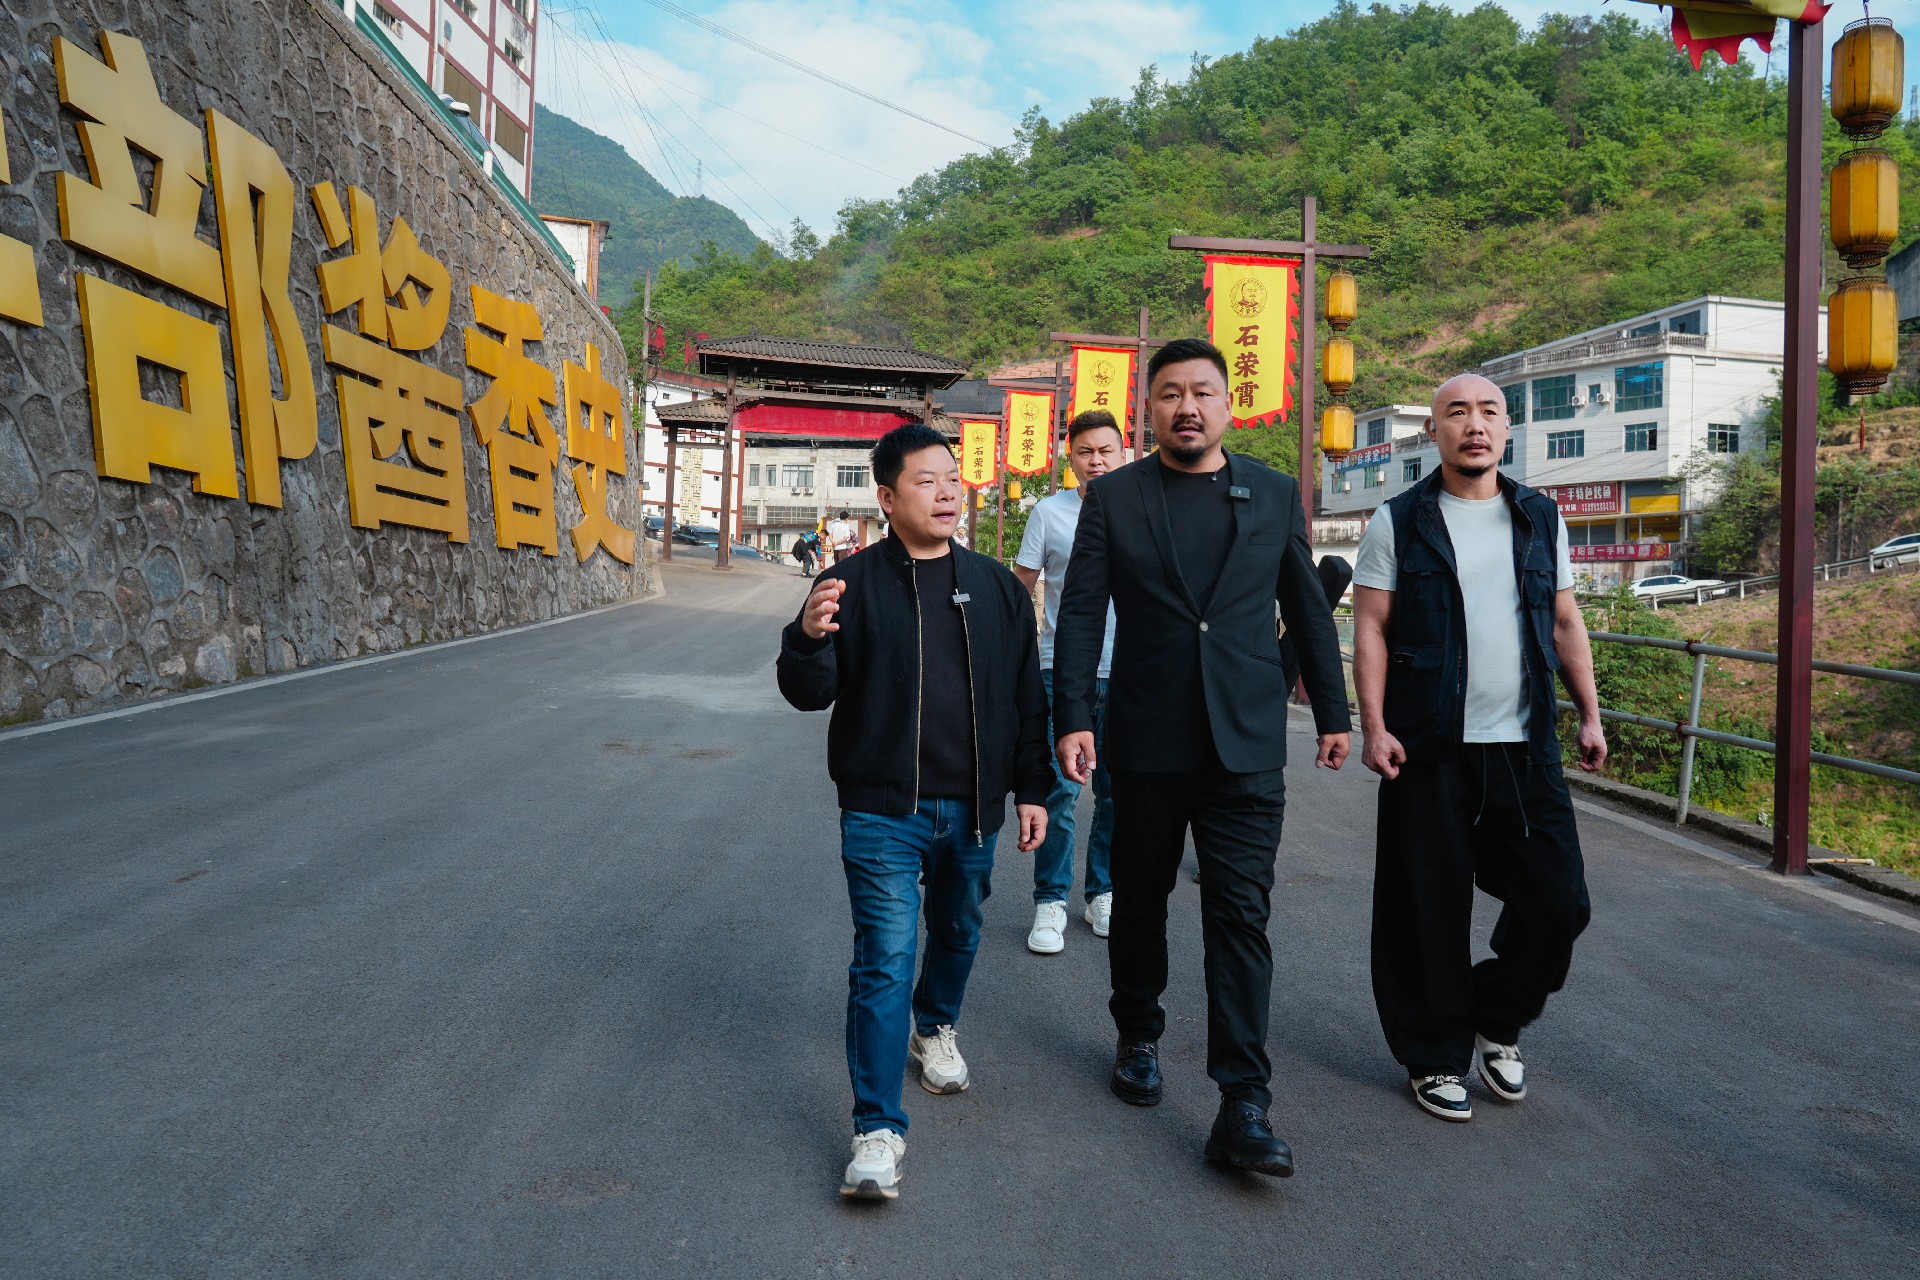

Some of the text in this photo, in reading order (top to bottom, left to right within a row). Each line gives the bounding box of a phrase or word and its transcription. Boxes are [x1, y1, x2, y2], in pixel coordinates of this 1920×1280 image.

[0, 31, 635, 566] 部酱香史
[1234, 324, 1260, 409] 石荣霄
[973, 446, 984, 480] 石荣霄
[1022, 425, 1035, 467] 石荣霄
